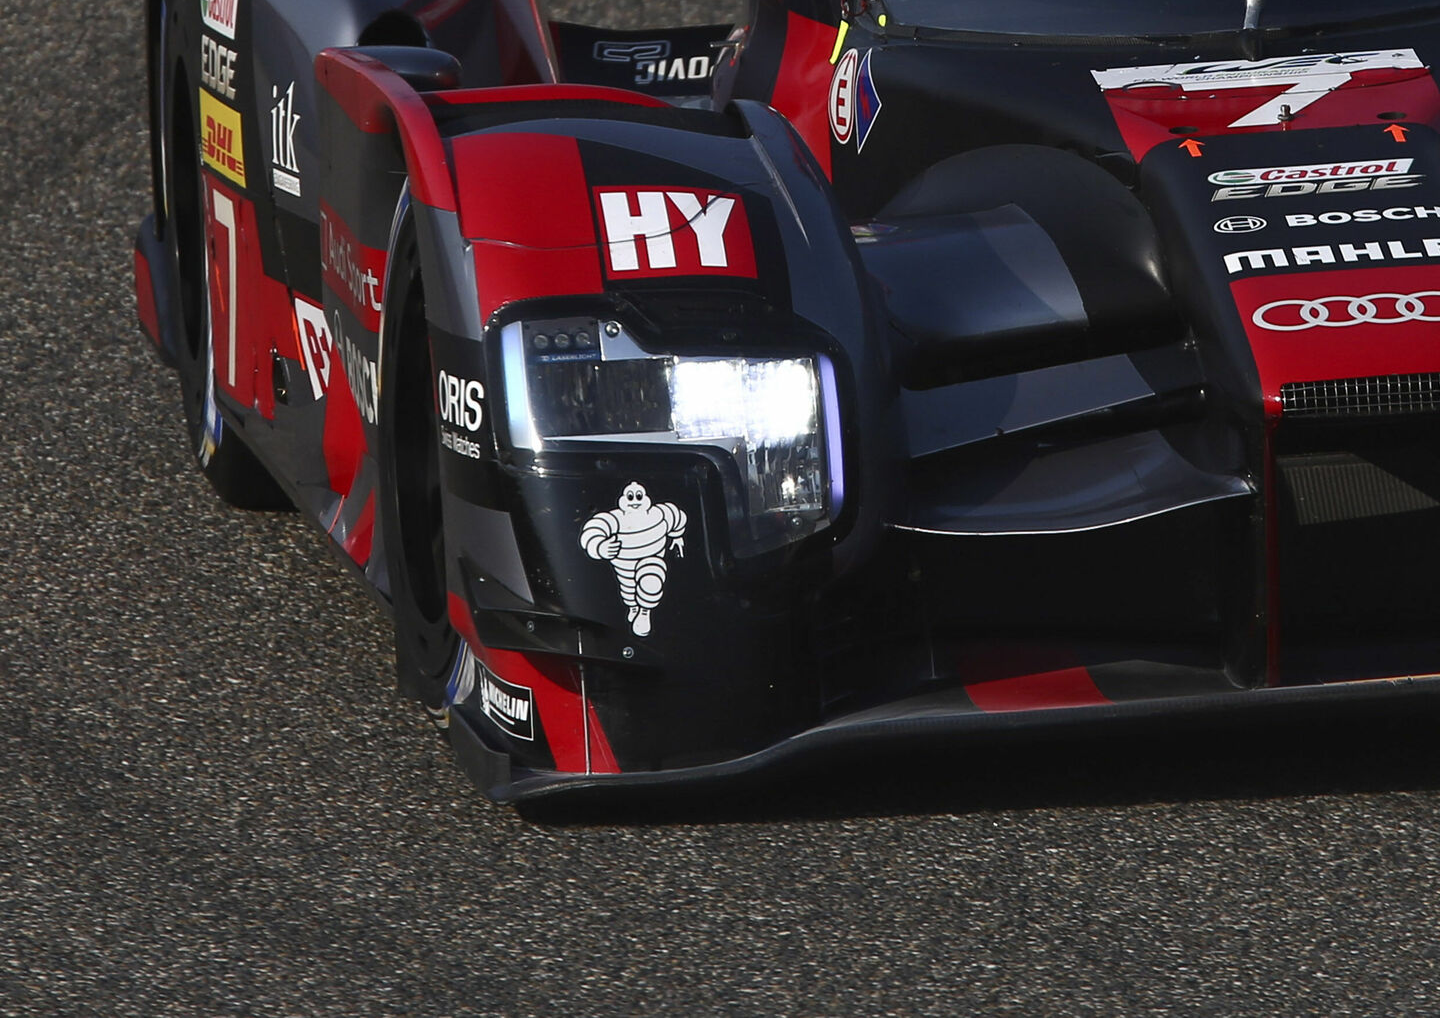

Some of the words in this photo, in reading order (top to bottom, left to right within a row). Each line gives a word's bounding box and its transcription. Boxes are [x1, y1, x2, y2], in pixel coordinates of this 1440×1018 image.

[202, 34, 238, 100] EDGE
[206, 114, 238, 173] DHL
[271, 80, 301, 173] itk
[1210, 173, 1427, 202] EDGE
[1260, 160, 1401, 181] Castrol
[600, 191, 736, 271] HY
[212, 188, 237, 388] 7
[439, 369, 485, 432] ORIS
